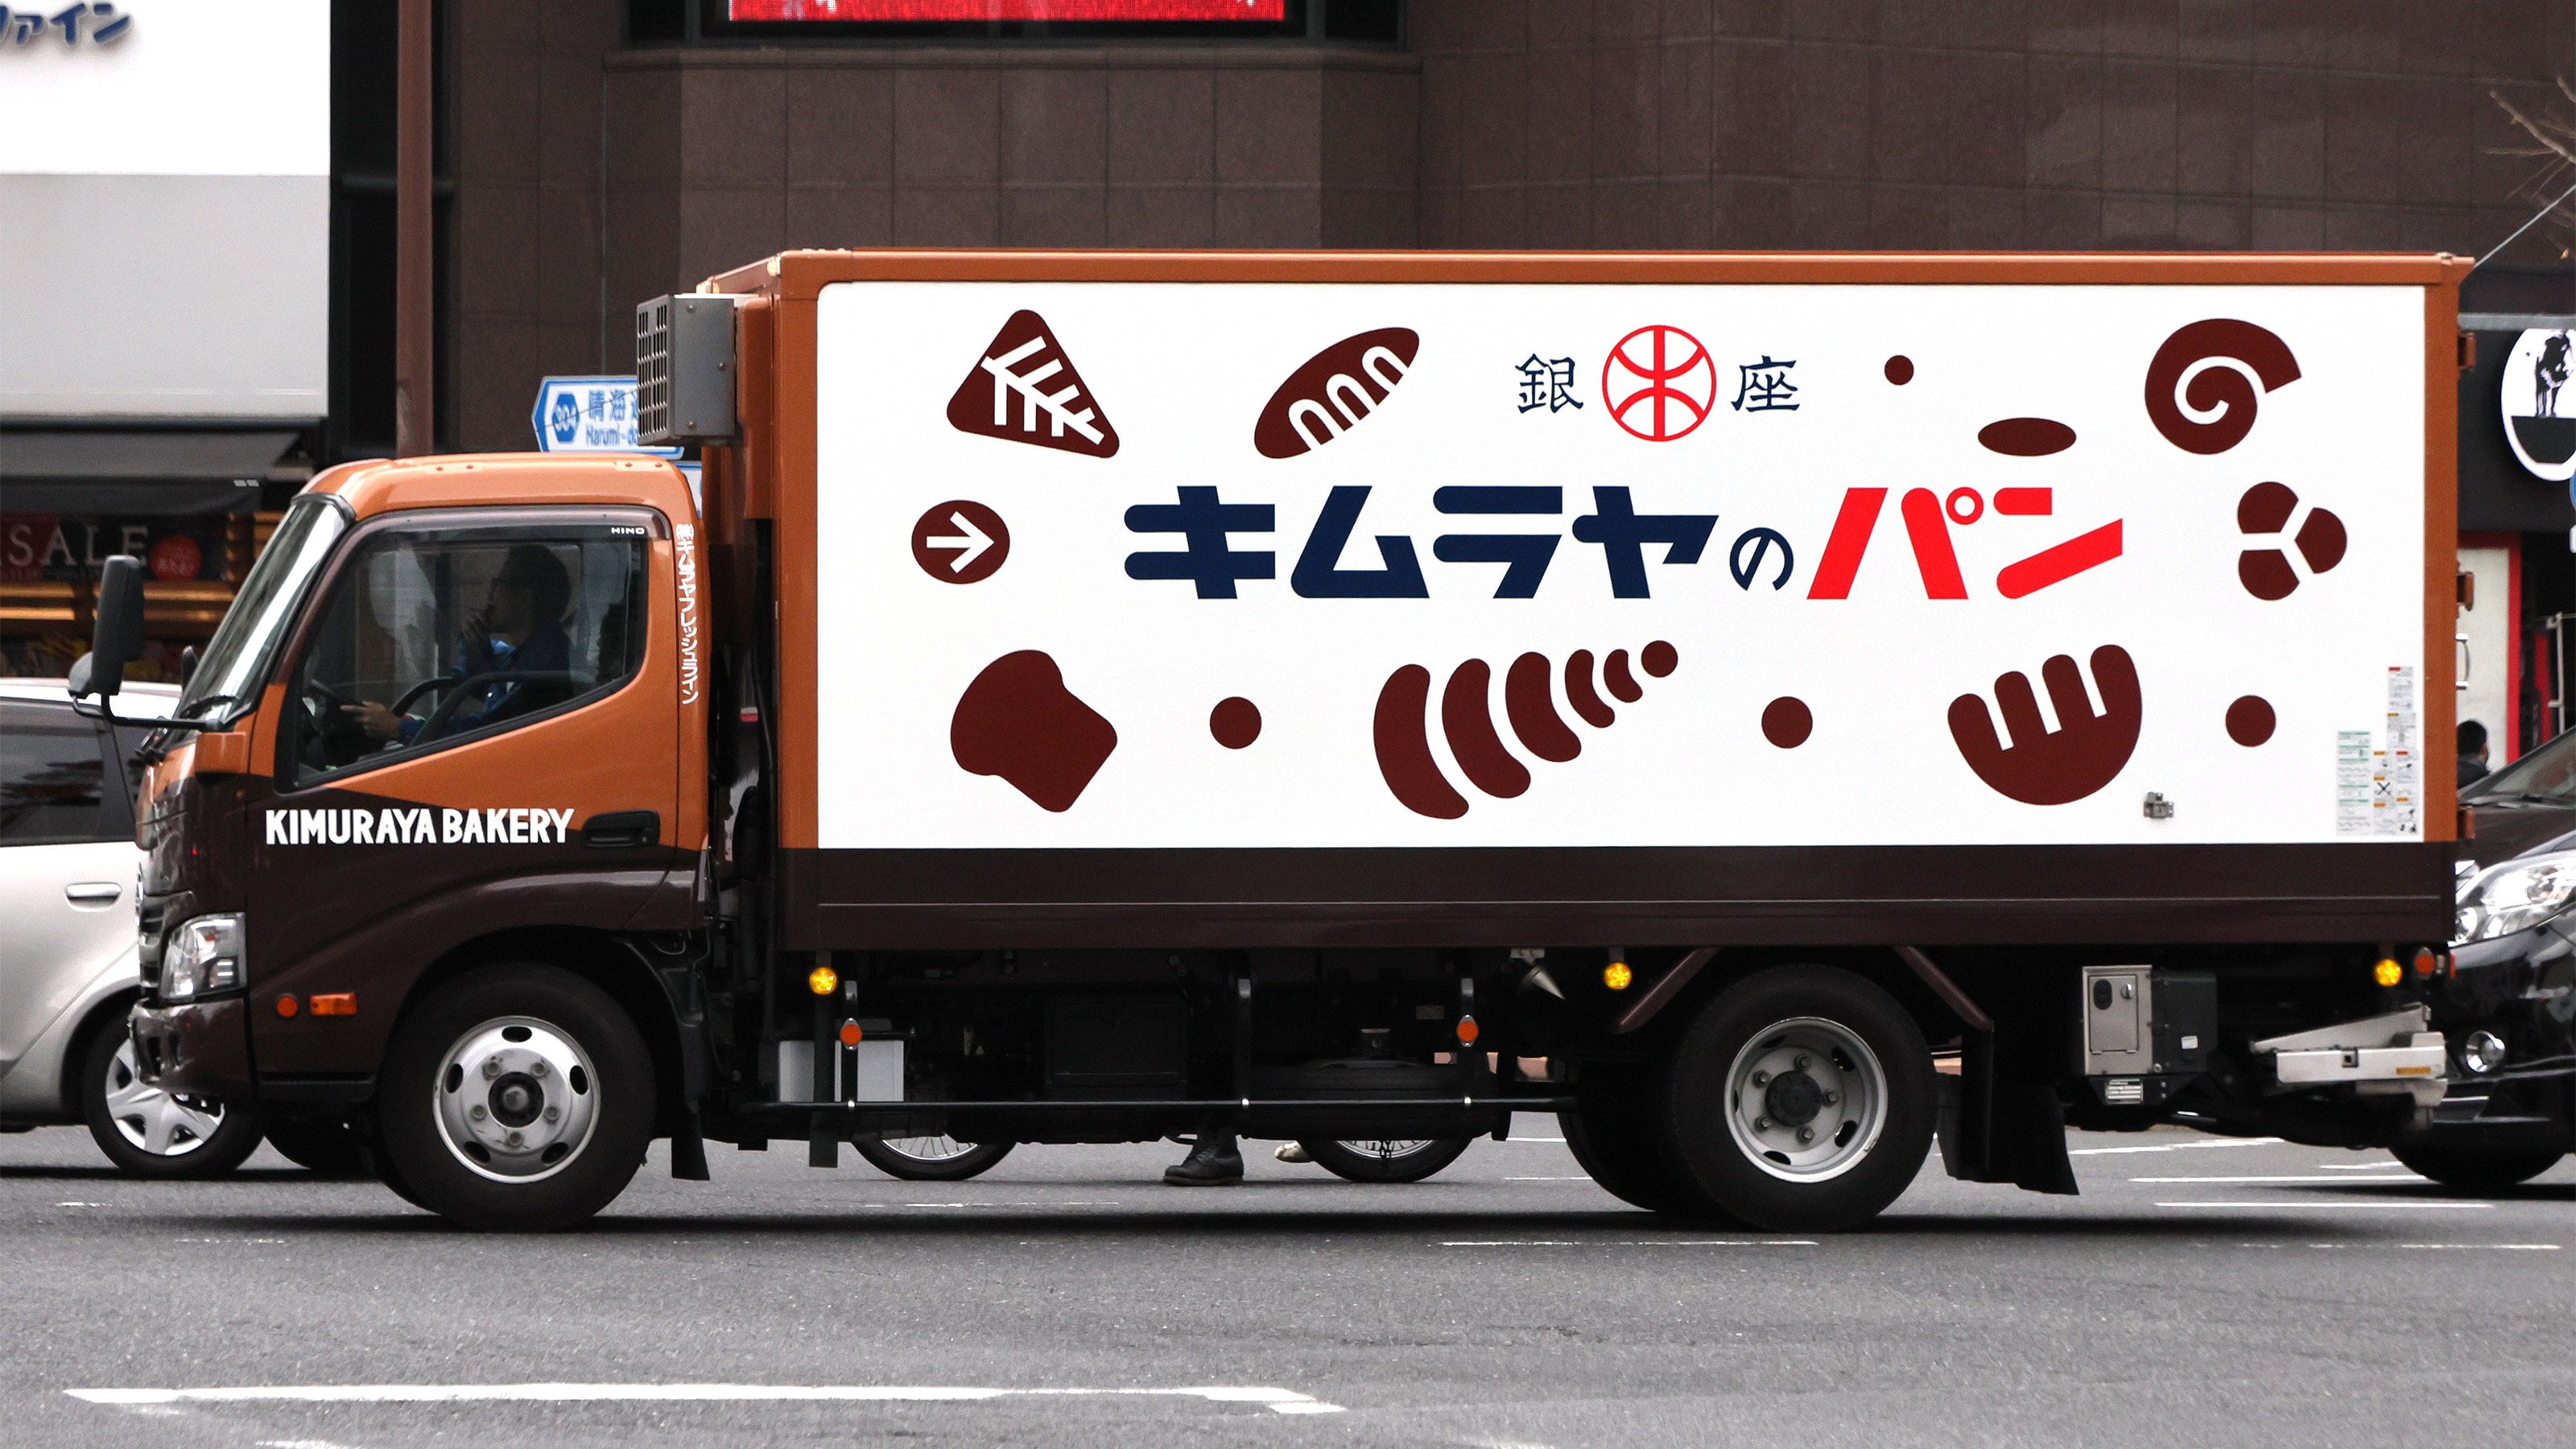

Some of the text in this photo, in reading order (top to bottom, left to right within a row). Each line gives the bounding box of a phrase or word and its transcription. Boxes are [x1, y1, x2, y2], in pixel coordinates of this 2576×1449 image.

[1515, 353, 1801, 414] 銀 座
[8, 524, 149, 567] SALE
[611, 527, 645, 535] HINO
[1124, 485, 2124, 600] キムラヤのパン
[266, 808, 575, 844] KIMURAYA BAKERY
